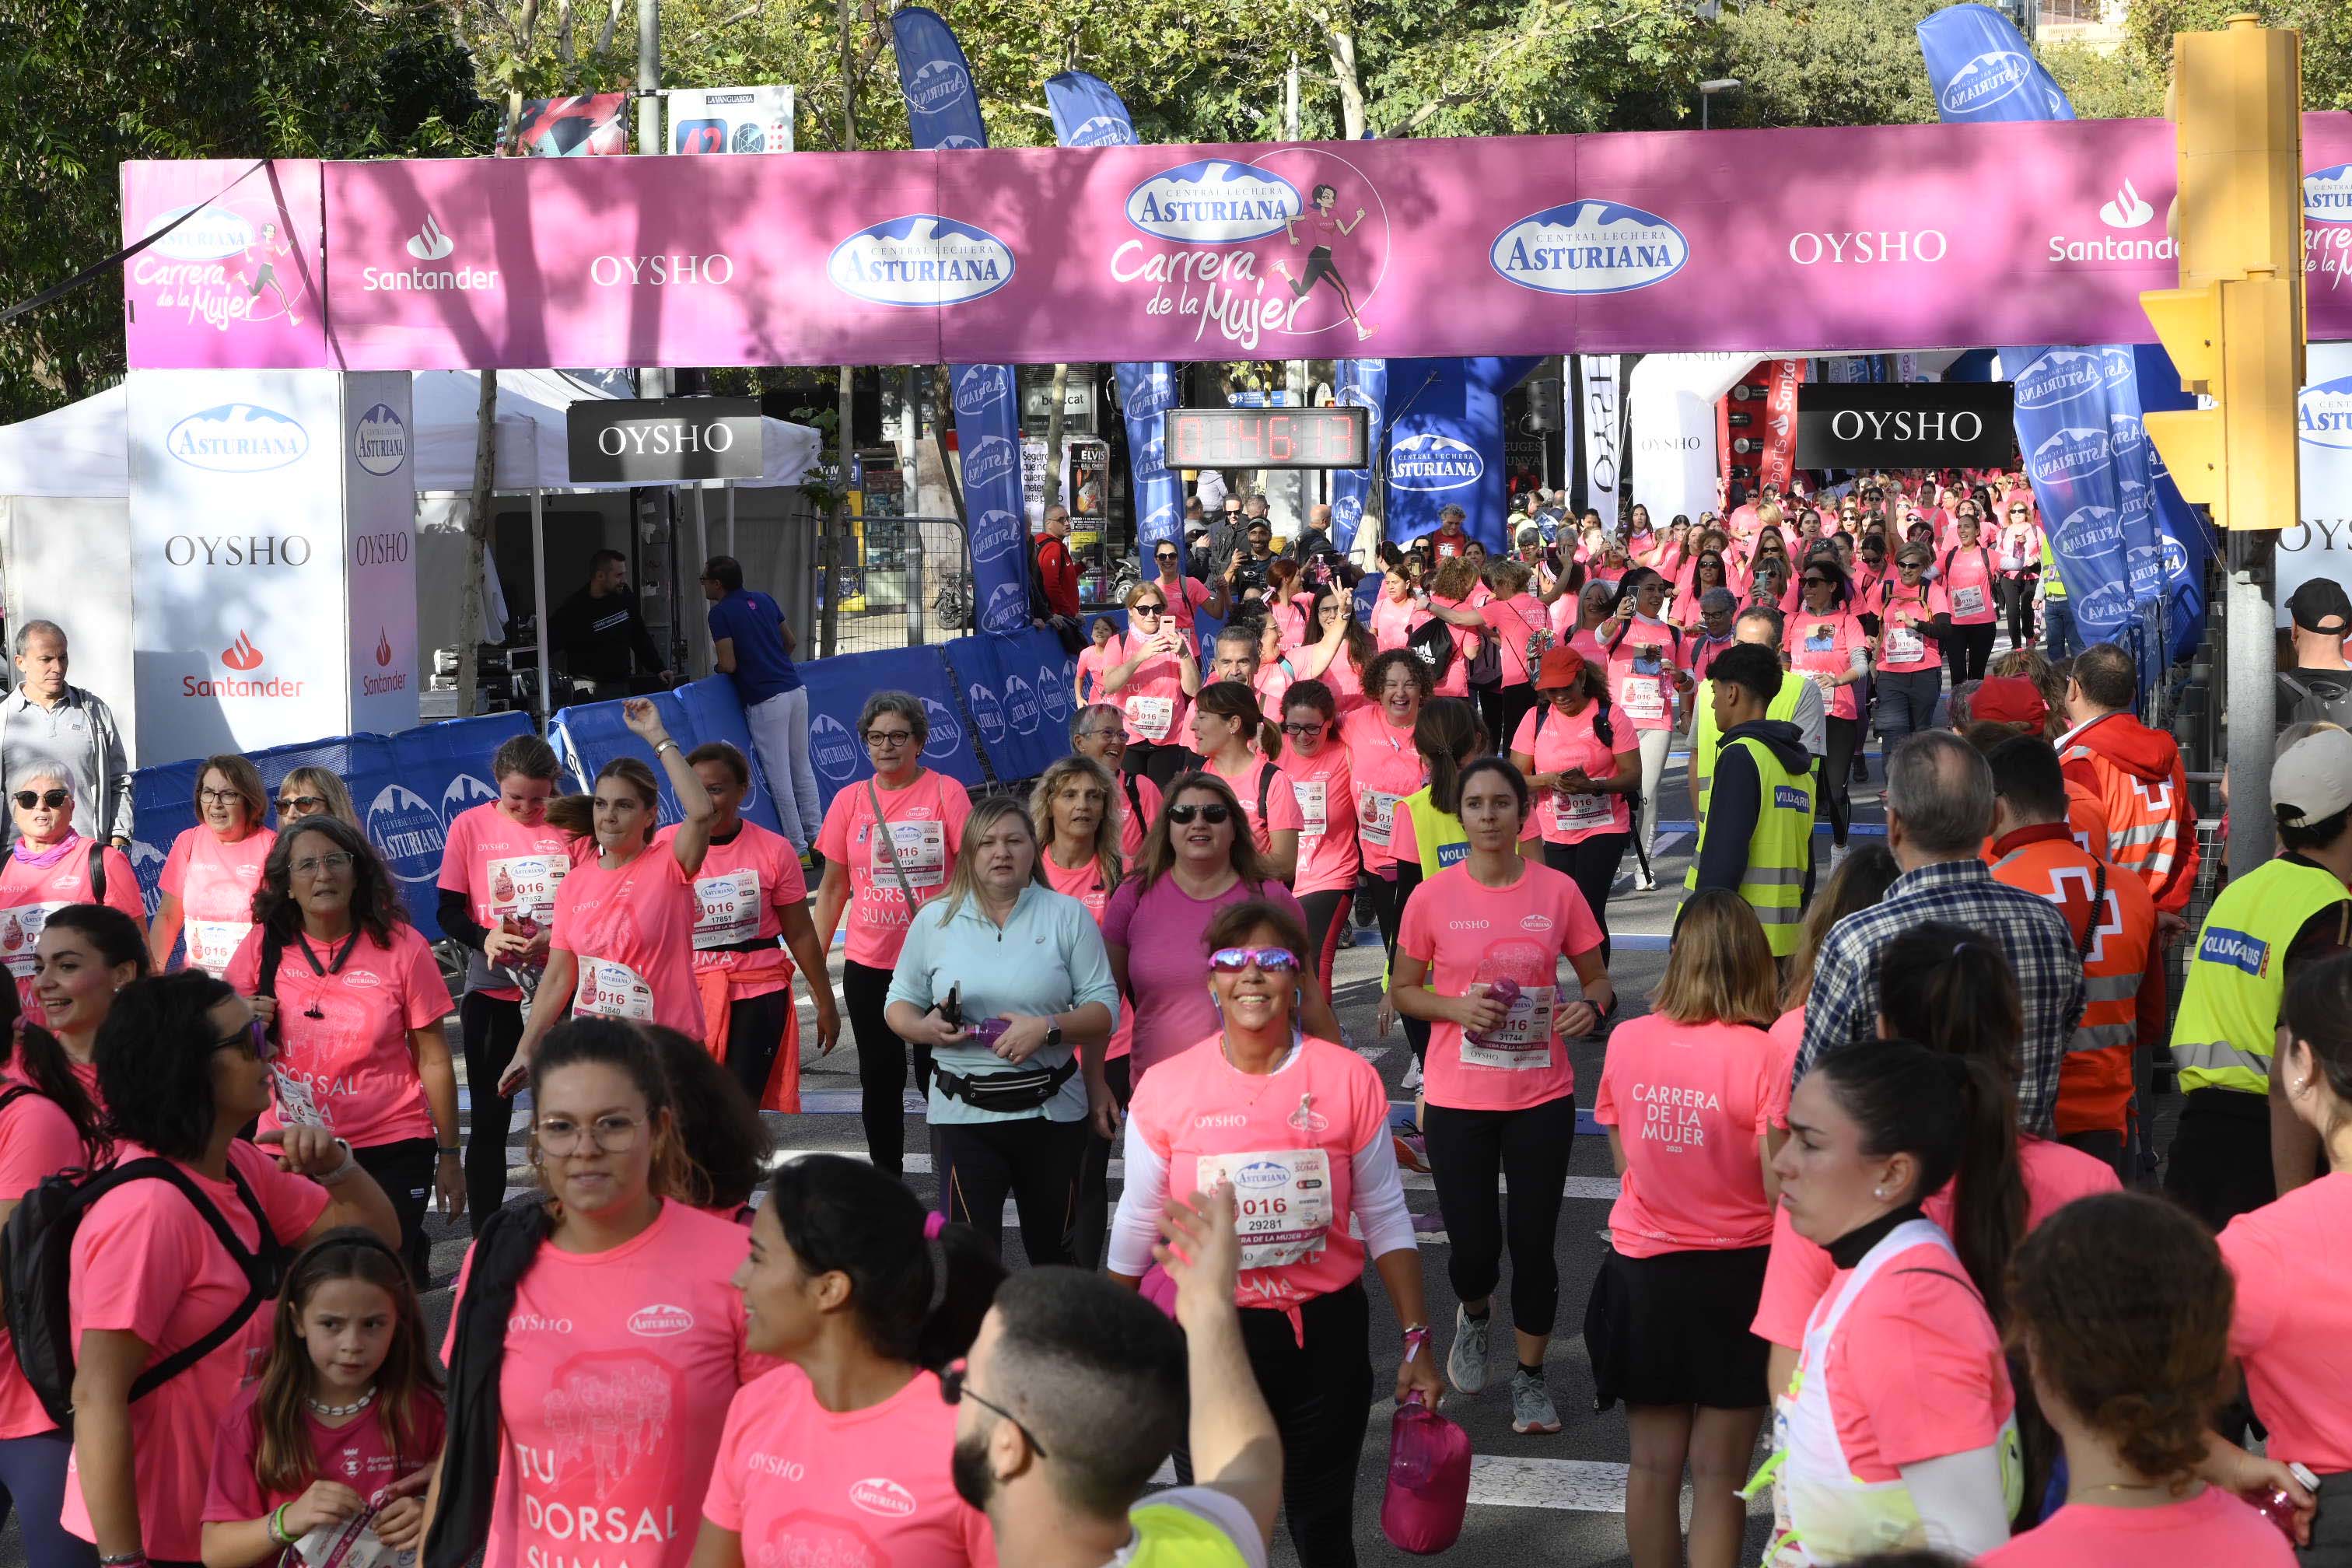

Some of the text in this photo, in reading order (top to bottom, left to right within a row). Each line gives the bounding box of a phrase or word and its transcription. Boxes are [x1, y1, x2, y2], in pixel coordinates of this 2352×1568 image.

[1166, 186, 1283, 198] CENTRAL LECHERA
[1139, 191, 1291, 223] ASTURIANA
[1536, 231, 1667, 243] CENTRAL LECHERA
[1789, 230, 1946, 264] OYSHO
[871, 245, 994, 257] CENTRAL LECHERA
[1110, 240, 1257, 283] Carrera
[1505, 236, 1673, 271] ASTURIANA
[2322, 251, 2335, 271] la
[134, 257, 226, 285] Carrera
[590, 254, 733, 286] OYSHO
[844, 249, 1000, 282] ASTURIANA
[363, 266, 499, 291] Santander
[157, 283, 261, 331] de la Mujer
[1146, 277, 1311, 350] de la Mujer
[1776, 359, 1797, 411] Santa
[1590, 355, 1615, 493] OYSH
[1832, 410, 1983, 442] OYSHO
[177, 429, 299, 456] ASTURIANA
[359, 433, 404, 459] ASTURIANA
[598, 422, 733, 455] OYSHO
[1178, 416, 1353, 460] 01:46:13
[1642, 436, 1700, 451] OYSHO
[1081, 450, 1105, 460] ELVIS
[1024, 463, 1036, 471] que
[1389, 457, 1477, 478] ASTURIANA
[165, 535, 311, 566] OYSHO
[356, 531, 408, 565] OYSHO
[183, 676, 304, 698] Santander
[363, 672, 407, 696] Santander
[1126, 684, 1140, 692] TU
[1573, 799, 1592, 807] 016
[374, 824, 445, 860] ASTURIANA
[896, 847, 919, 857] 016
[517, 882, 544, 894] 016
[707, 902, 734, 914] 016
[862, 907, 910, 925] SUMA
[712, 915, 732, 924] 17851
[1450, 920, 1489, 929] OYSHO
[205, 947, 227, 957] 016
[692, 950, 734, 965] UMA
[598, 990, 625, 1005] 016
[600, 1005, 621, 1015] 31840
[1471, 1051, 1499, 1061] OYSHO
[1633, 1083, 1720, 1111] CARRERA
[1195, 1114, 1246, 1129] OYSHO
[1647, 1104, 1702, 1127] DE LA
[1641, 1122, 1704, 1146] MUJER
[1239, 1173, 1287, 1184] ASTURIANA
[1295, 1164, 1319, 1173] SUMA
[1244, 1198, 1287, 1215] 016
[1249, 1220, 1282, 1230] 29281
[1276, 1232, 1301, 1241] MUJER
[509, 1313, 572, 1334] OYSHO
[633, 1316, 688, 1330] ASTURIANA
[516, 1444, 555, 1484] TU
[748, 1452, 804, 1482] OYSHO
[855, 1486, 910, 1513] ASTURIANA
[525, 1494, 678, 1543] DORSAL
